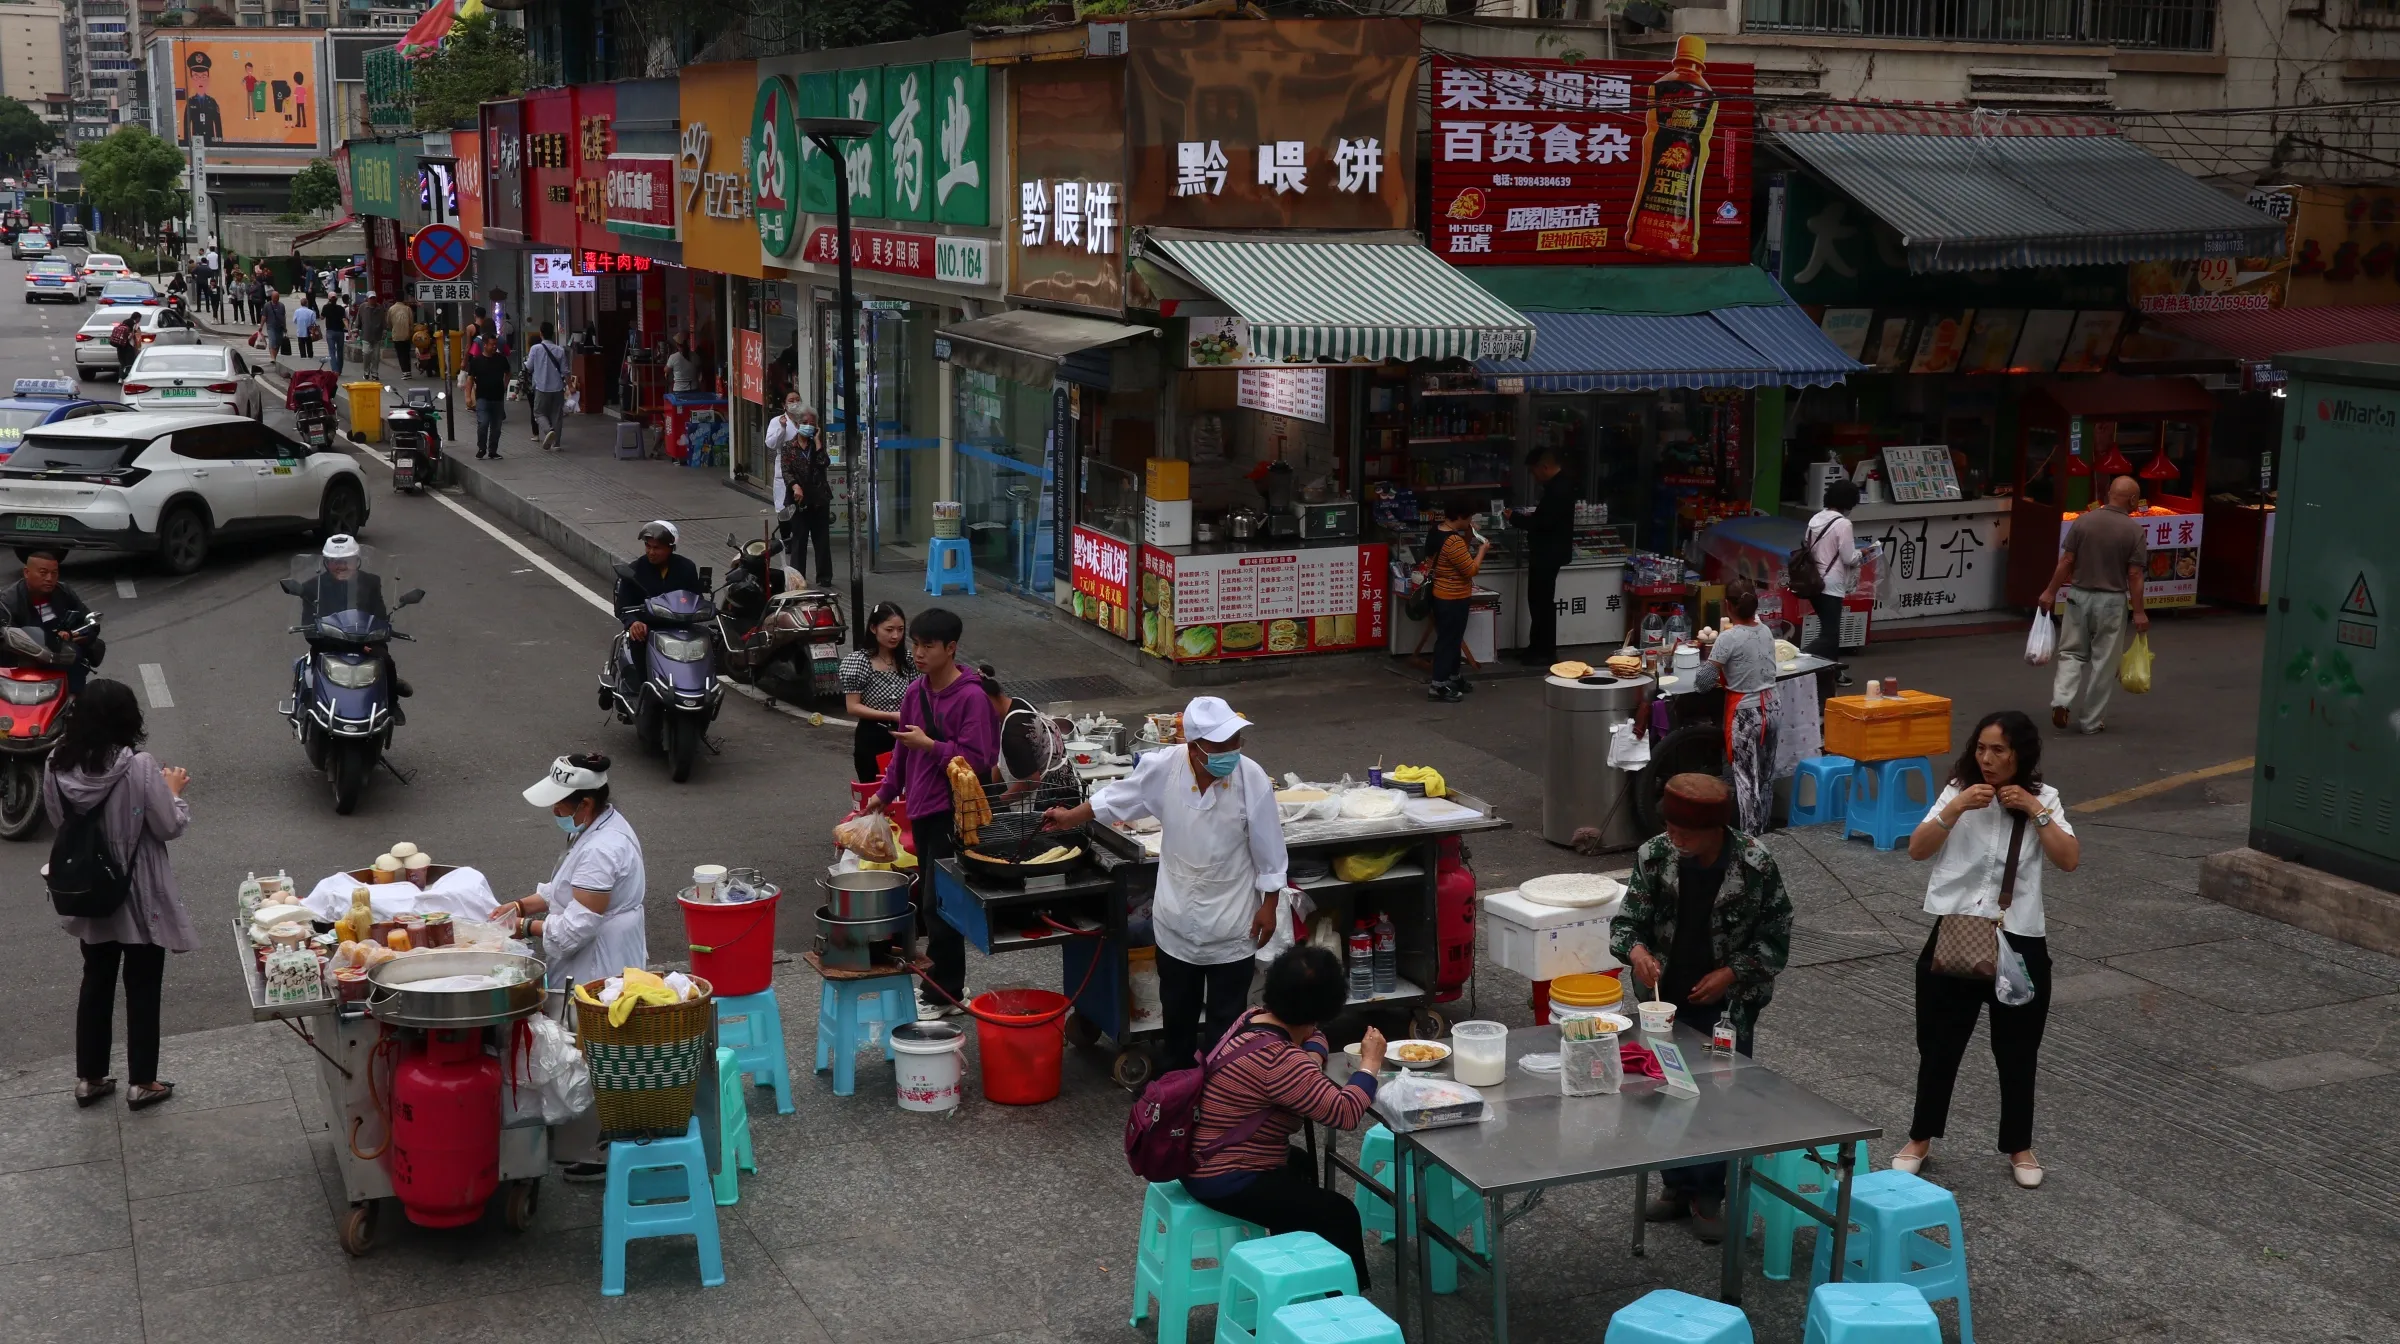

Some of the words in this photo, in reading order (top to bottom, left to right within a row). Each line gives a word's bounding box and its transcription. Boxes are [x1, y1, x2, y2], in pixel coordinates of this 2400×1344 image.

[1440, 67, 1633, 113] 荣登烟酒
[1440, 121, 1632, 165] 百货食杂
[1177, 137, 1384, 197] 黔喂饼
[358, 156, 392, 204] 中国邮政
[1514, 176, 1571, 187] 18984384639
[1022, 178, 1118, 254] 黔喂饼
[1449, 224, 1493, 233] HI-TIGER
[1449, 233, 1493, 253] 乐虎
[598, 252, 651, 271] 牛肉粉
[818, 232, 862, 263] 更多心
[871, 237, 920, 270] 更多照顾
[937, 243, 982, 280] NO.164
[2200, 259, 2228, 281] 9.9
[419, 284, 471, 301] 严管路段
[2191, 296, 2269, 310] 13721594502
[1073, 533, 1129, 587] 黔味煎饼
[1605, 594, 1622, 612] 草
